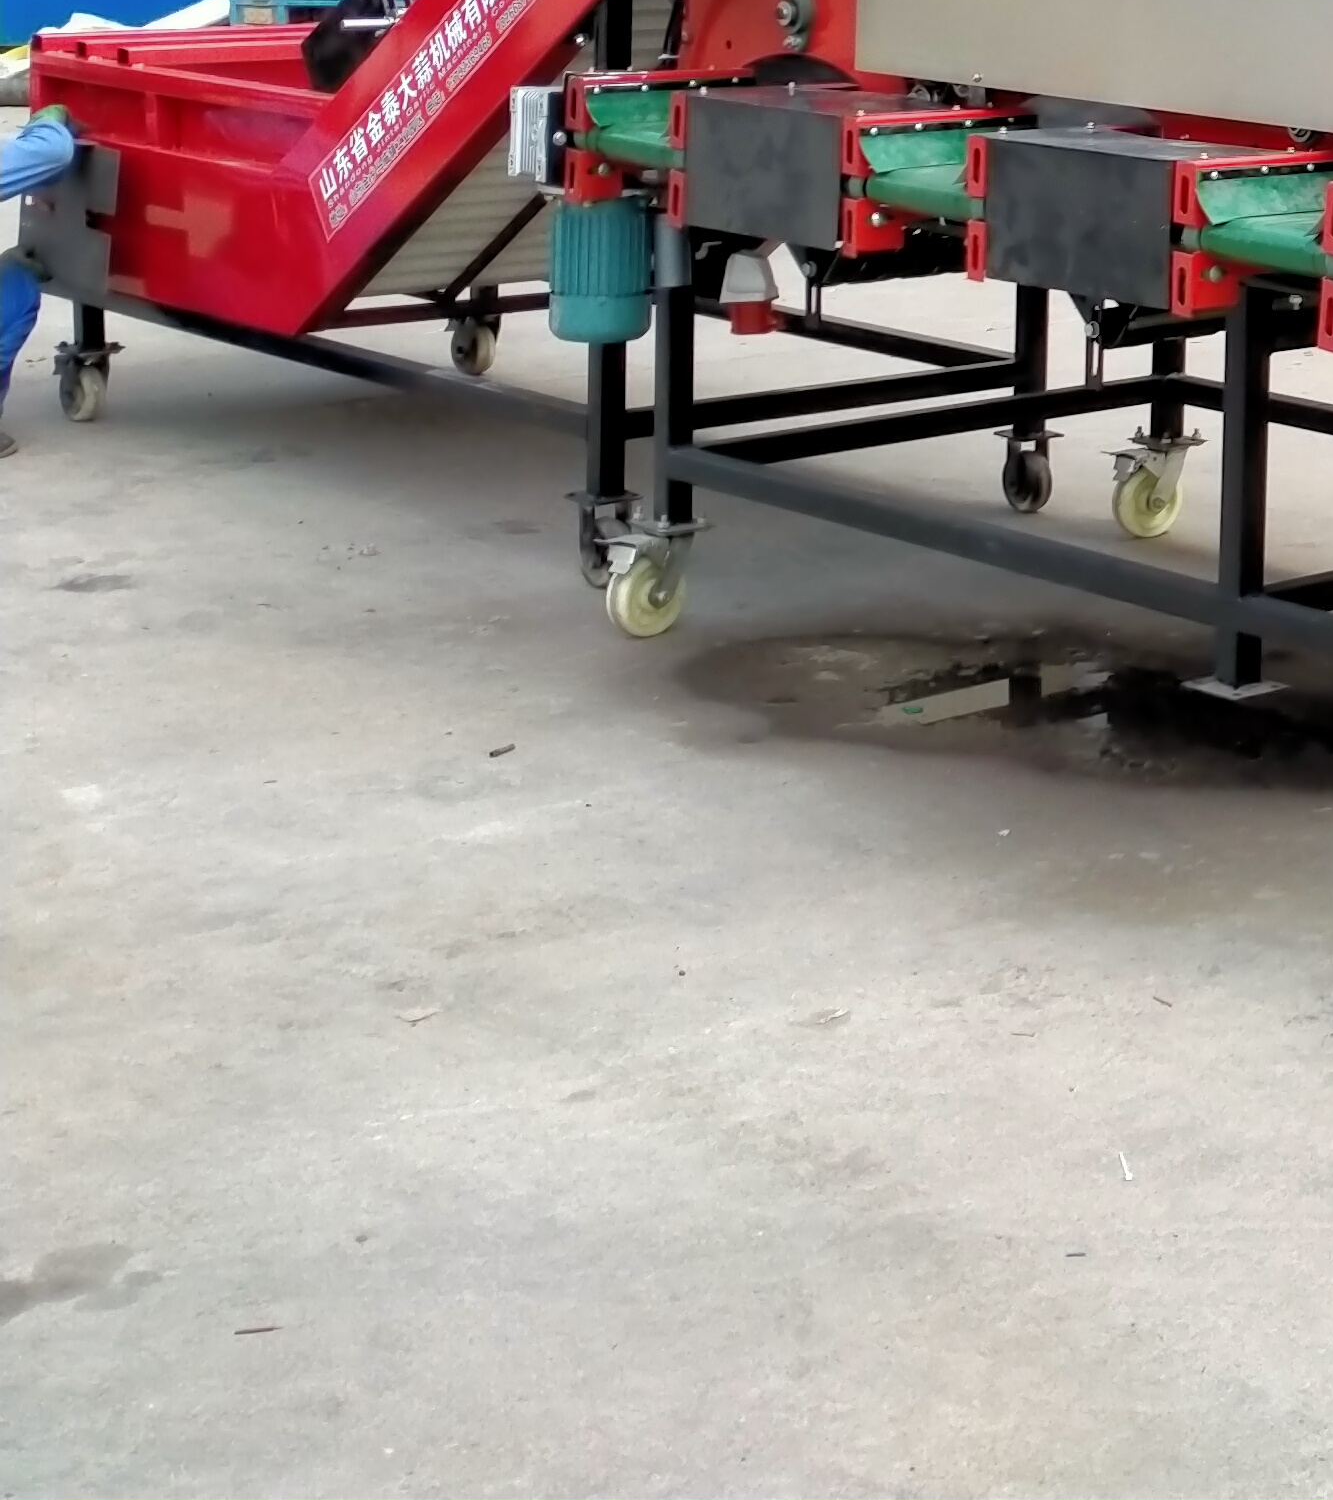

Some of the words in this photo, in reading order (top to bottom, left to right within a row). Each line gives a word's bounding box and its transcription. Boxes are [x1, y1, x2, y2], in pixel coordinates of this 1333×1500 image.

[328, 153, 374, 208] Shandong
[406, 82, 436, 116] Garlic
[437, 19, 489, 79] Machinery
